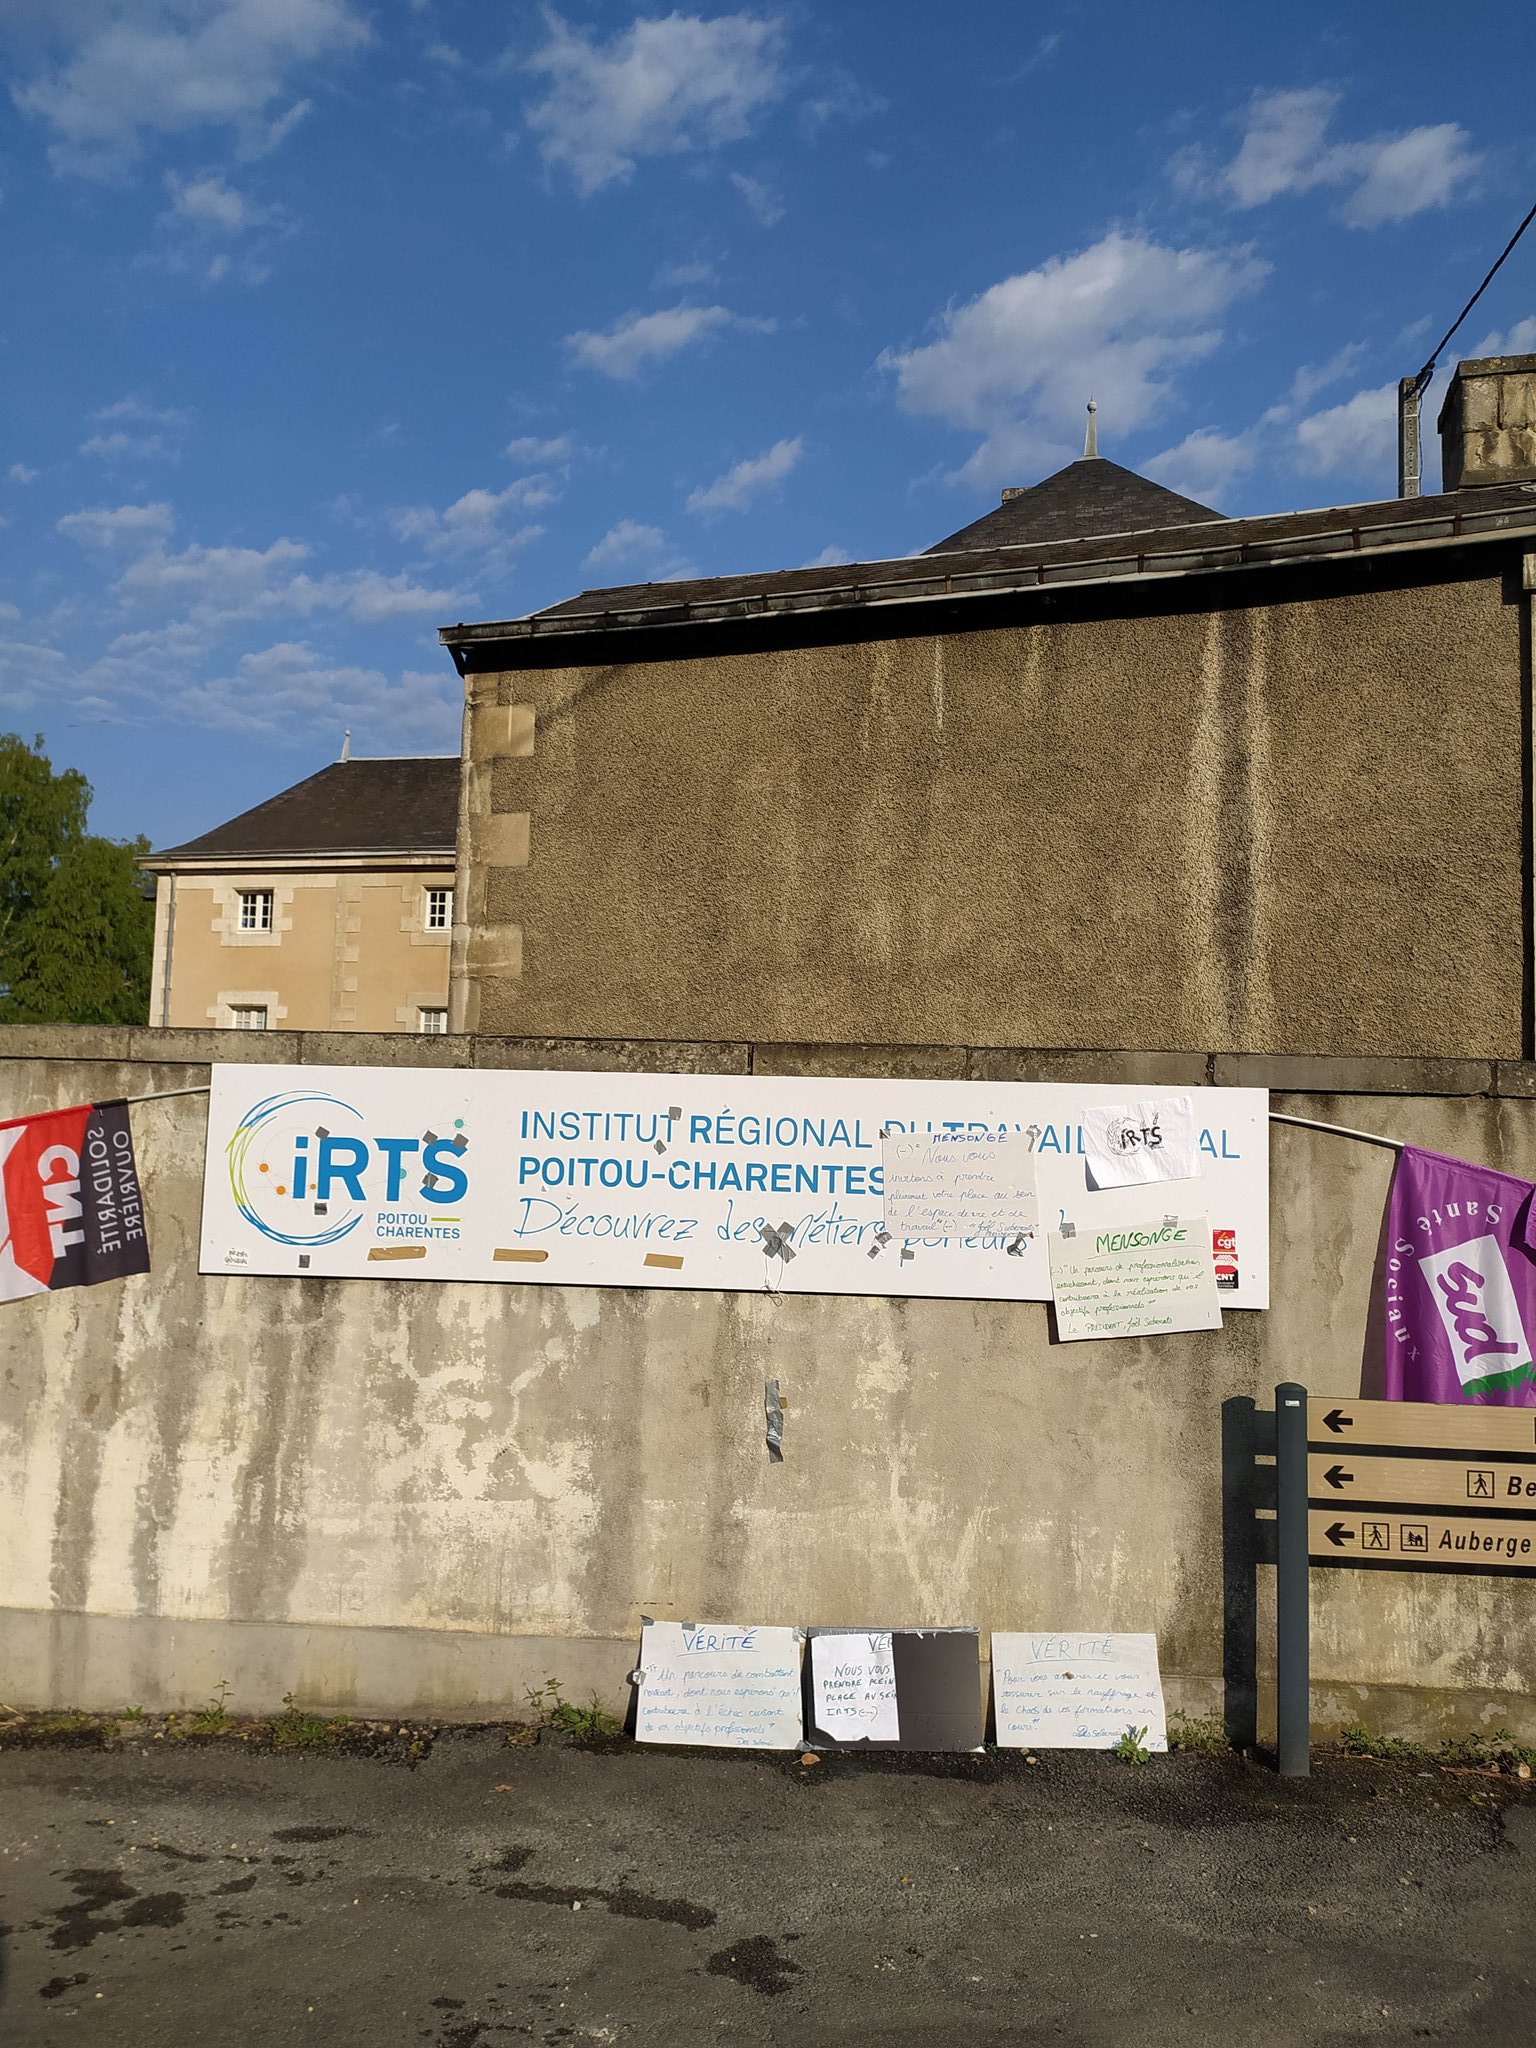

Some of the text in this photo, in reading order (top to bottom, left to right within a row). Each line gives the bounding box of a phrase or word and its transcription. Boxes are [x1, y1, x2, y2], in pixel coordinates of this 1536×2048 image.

[521, 1108, 873, 1149] INSTITUT RÉGIONAL
[932, 1132, 1008, 1144] MENSONGE
[922, 1146, 957, 1165] Nous
[962, 1151, 996, 1163] vous
[519, 1156, 884, 1195] POITOU-CHARENTES
[953, 1171, 996, 1186] prendre
[933, 1189, 954, 1199] votre
[959, 1188, 989, 1202] place
[993, 1192, 1008, 1200] au
[1013, 1189, 1037, 1200] sein
[377, 1213, 428, 1225] POITOU
[888, 1207, 899, 1217] de
[957, 1208, 968, 1218] de
[991, 1208, 1007, 1218] et
[1008, 1208, 1028, 1218] de
[1416, 1200, 1503, 1236] Santé
[513, 1197, 699, 1241] Découvrez
[717, 1199, 765, 1243] des
[376, 1225, 461, 1239] CHARENTES
[1096, 1227, 1188, 1254] MENSONGE
[1217, 1237, 1237, 1250] cgt
[1083, 1264, 1113, 1277] parcours
[1115, 1263, 1124, 1271] de
[1215, 1273, 1235, 1281] CNT
[1103, 1275, 1121, 1285] dont
[1171, 1284, 1182, 1292] de
[1387, 1237, 1421, 1362] Sociaux
[1067, 1322, 1080, 1334] Le
[1438, 1529, 1532, 1559] Auberge
[834, 1662, 891, 1678] NOUS VOUS
[1095, 1673, 1109, 1681] et
[1114, 1673, 1140, 1681] vous
[682, 1671, 728, 1685] parcours
[823, 1679, 863, 1690] PRENDRE
[826, 1692, 857, 1703] PLACE
[1047, 1689, 1067, 1697] sur
[1042, 1705, 1053, 1714] de
[1137, 1708, 1158, 1718] en
